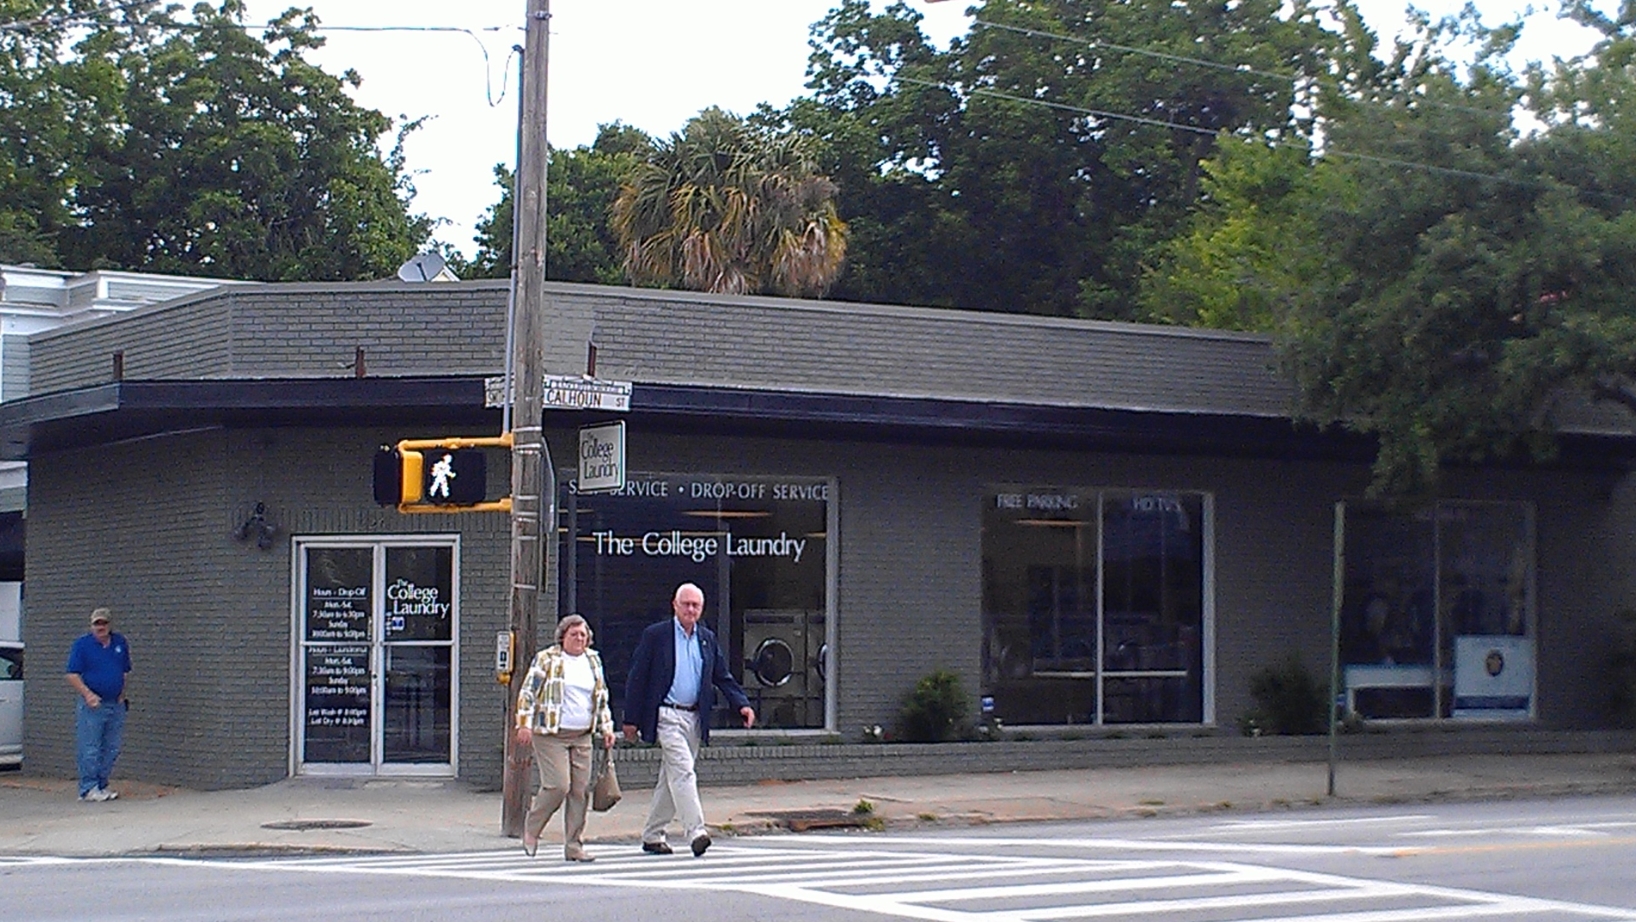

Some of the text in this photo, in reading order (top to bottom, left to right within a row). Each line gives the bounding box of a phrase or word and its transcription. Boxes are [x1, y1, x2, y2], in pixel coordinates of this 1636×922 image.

[547, 389, 626, 407] CALHOUN ST
[581, 438, 614, 463] College
[584, 457, 619, 482] Laundry
[691, 482, 829, 500] DROP-OFF SERVICE
[997, 494, 1078, 510] FREE PARKING
[592, 530, 806, 562] The College Laundry
[387, 583, 439, 604] College
[393, 598, 450, 619] Laundry
